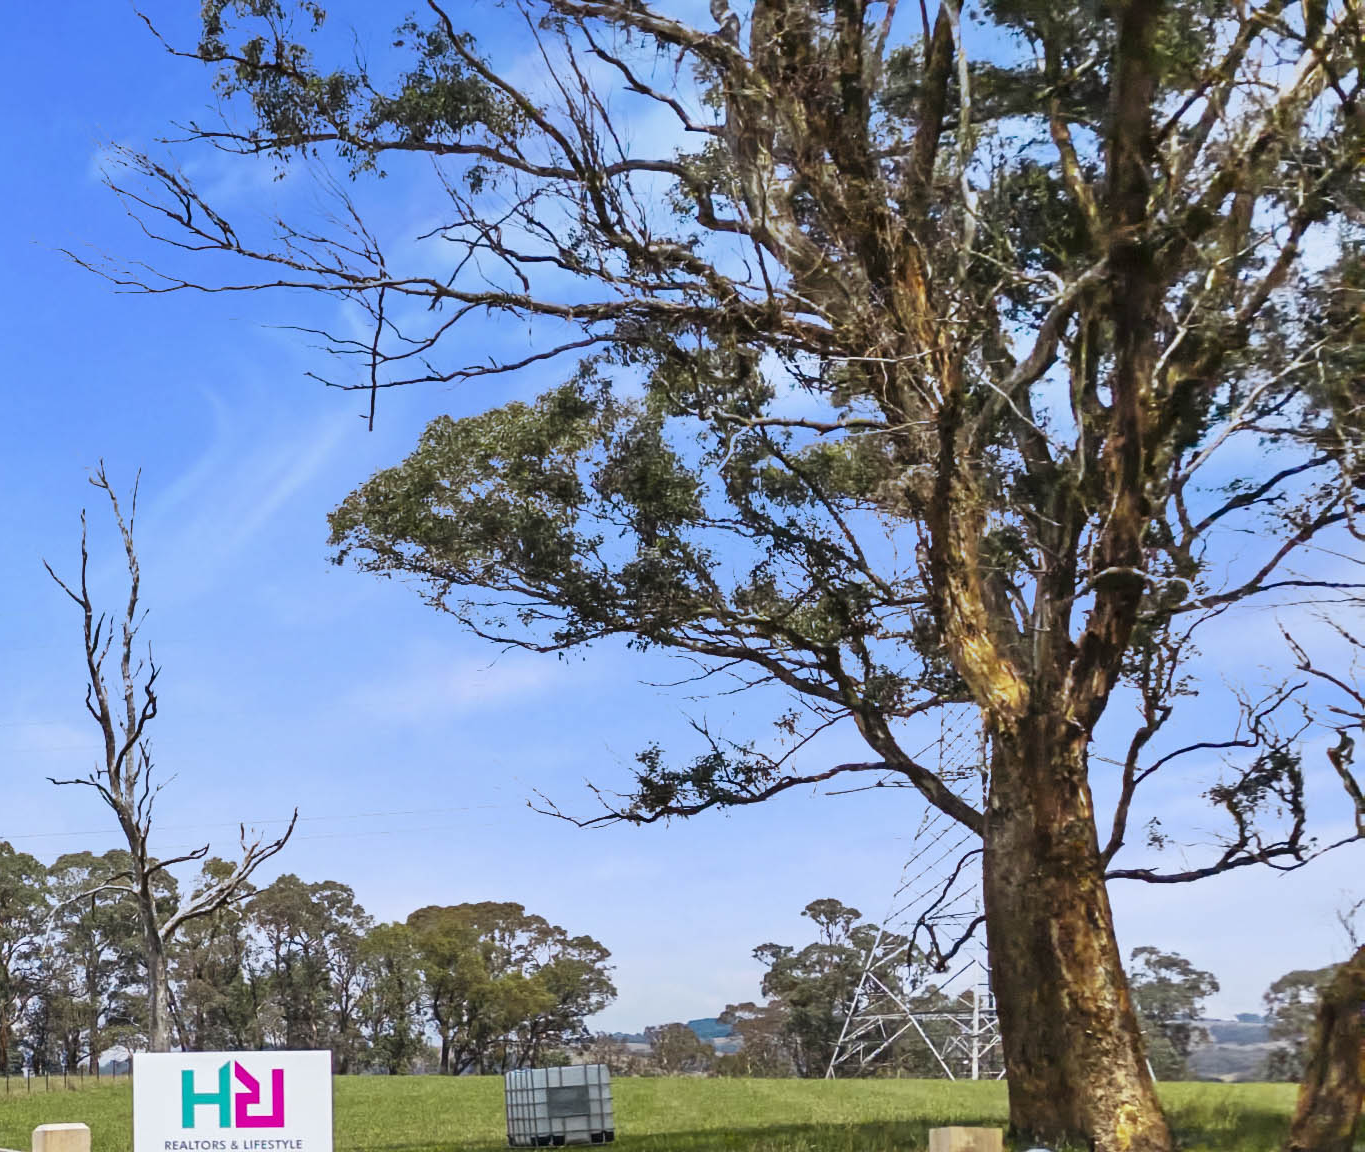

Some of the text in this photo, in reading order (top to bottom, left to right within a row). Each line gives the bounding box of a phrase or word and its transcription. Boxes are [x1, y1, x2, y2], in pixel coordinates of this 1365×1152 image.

[164, 1139, 302, 1150] REALTORS & LIFESTYLE
